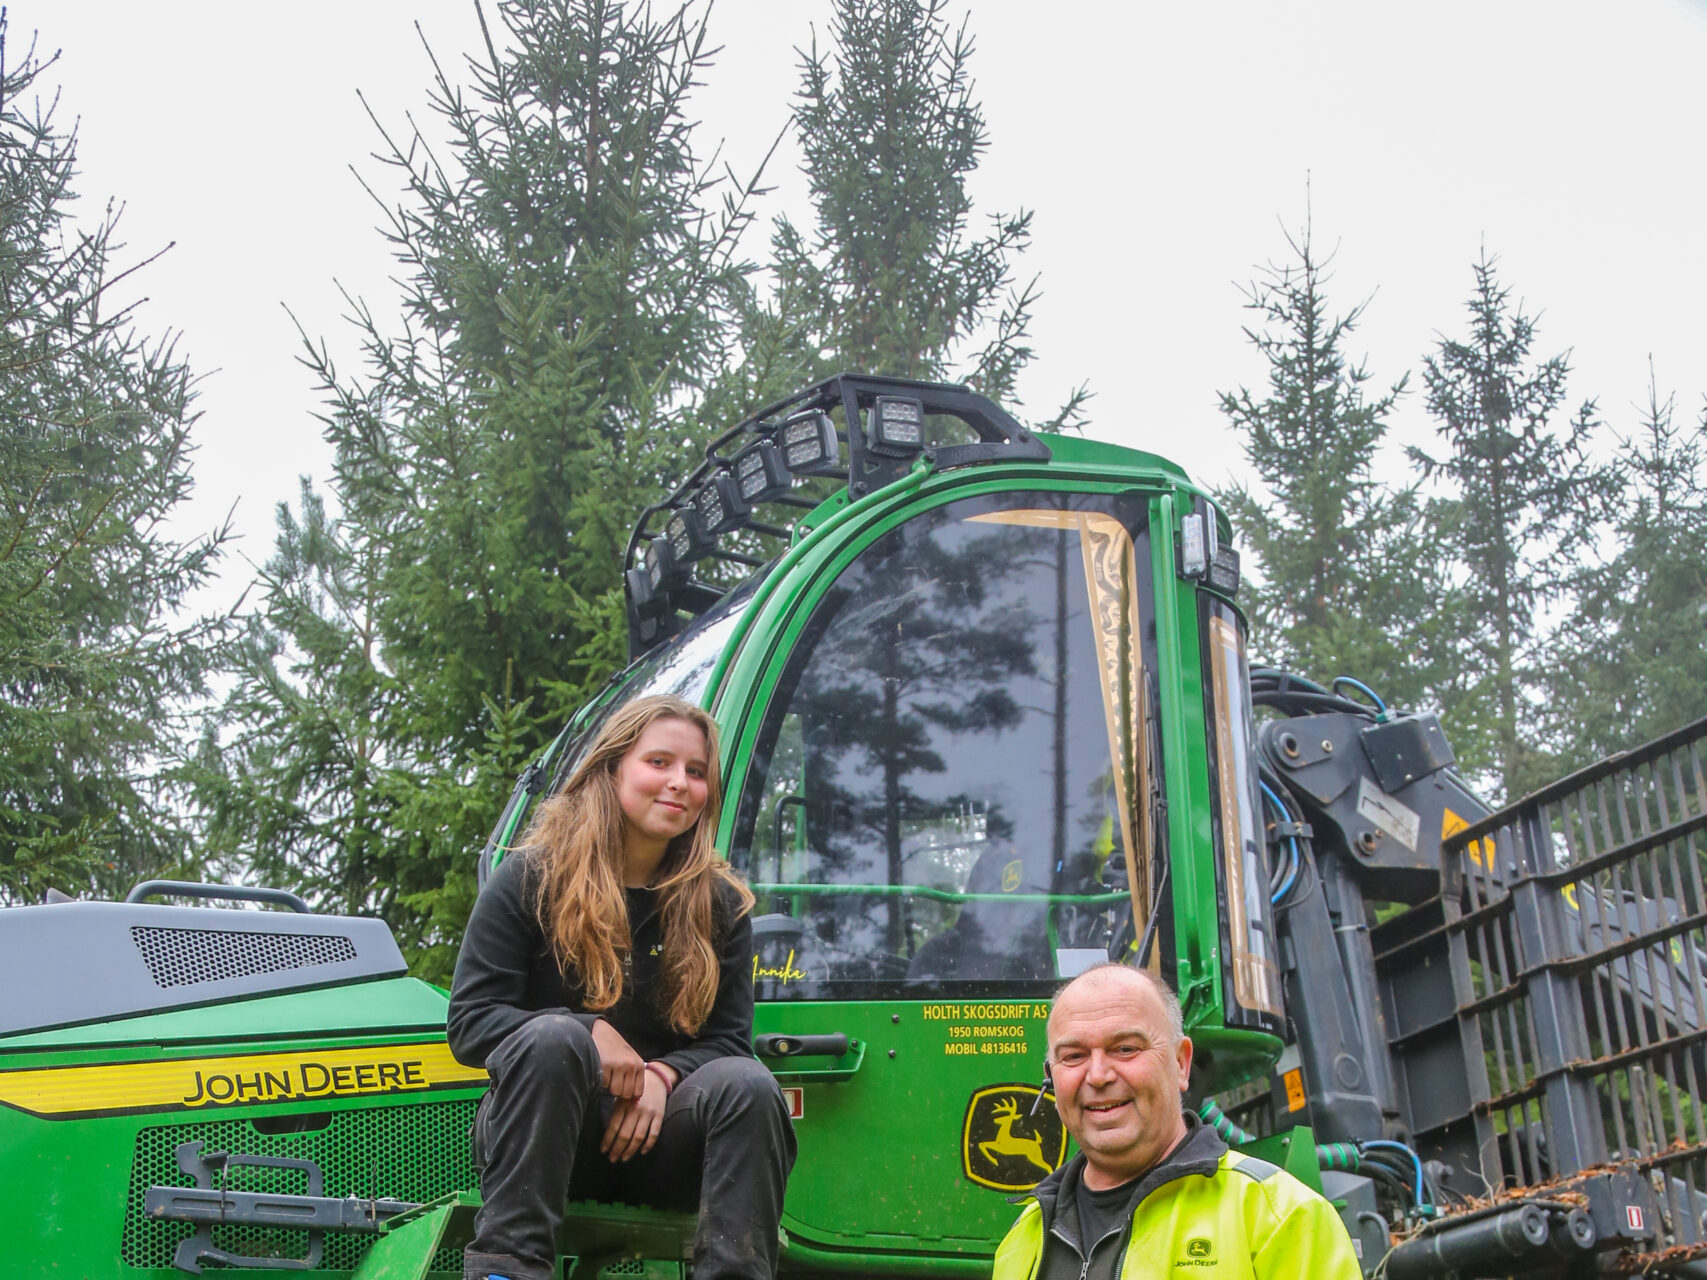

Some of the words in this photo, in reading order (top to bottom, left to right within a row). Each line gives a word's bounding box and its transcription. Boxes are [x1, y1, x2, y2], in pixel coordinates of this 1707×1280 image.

[923, 1005, 960, 1019] HOLTH
[963, 1004, 1030, 1019] SKOGSDRIFT
[1032, 1004, 1048, 1018] AS
[948, 1026, 971, 1037] 1950
[973, 1025, 1024, 1037] RØMSKOG
[945, 1043, 978, 1055] MOBIL
[980, 1042, 1028, 1054] 48136416
[183, 1070, 294, 1104] JOHN
[299, 1060, 427, 1094] DEERE
